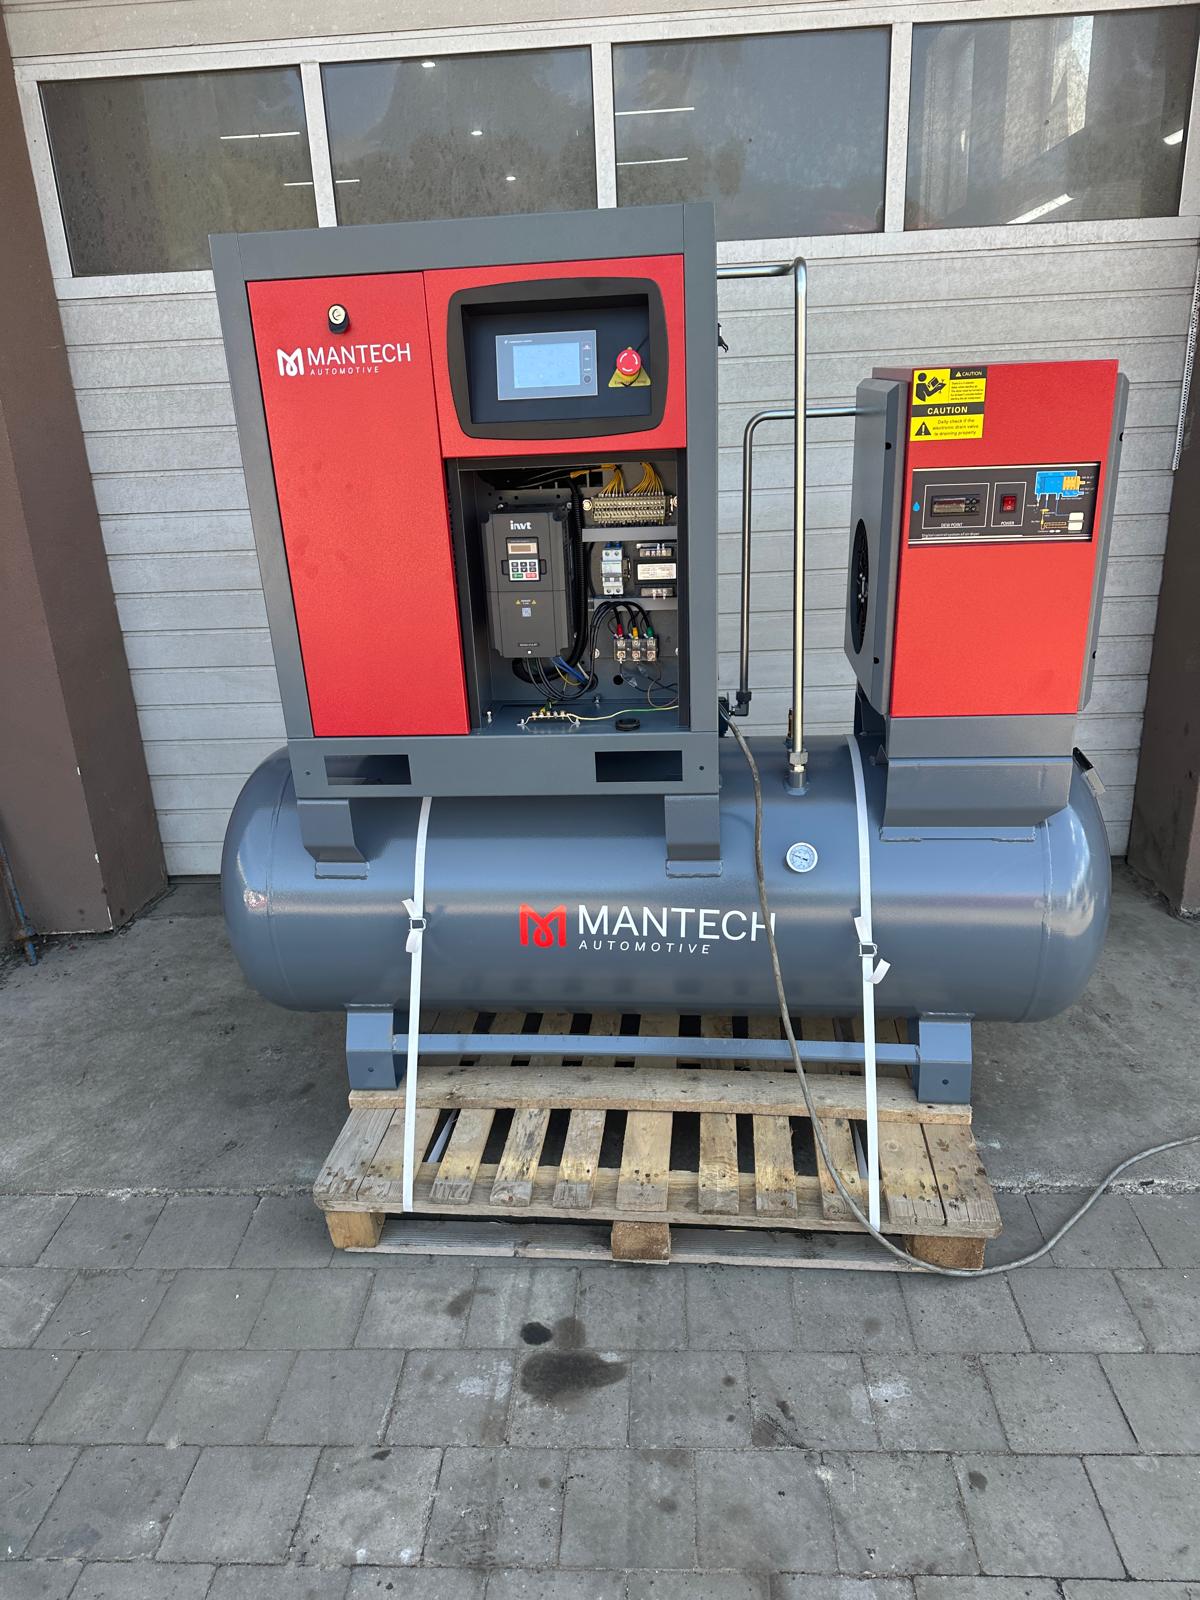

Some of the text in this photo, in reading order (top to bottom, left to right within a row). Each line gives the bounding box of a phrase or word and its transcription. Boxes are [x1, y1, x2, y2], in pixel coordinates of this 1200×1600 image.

[307, 342, 412, 367] MANTECH
[310, 366, 380, 376] AUTOMOTIVE
[927, 406, 968, 415] CAUTION
[510, 520, 532, 530] invt
[578, 904, 776, 942] MANTECH
[578, 939, 711, 955] AUTOMOTIVE
